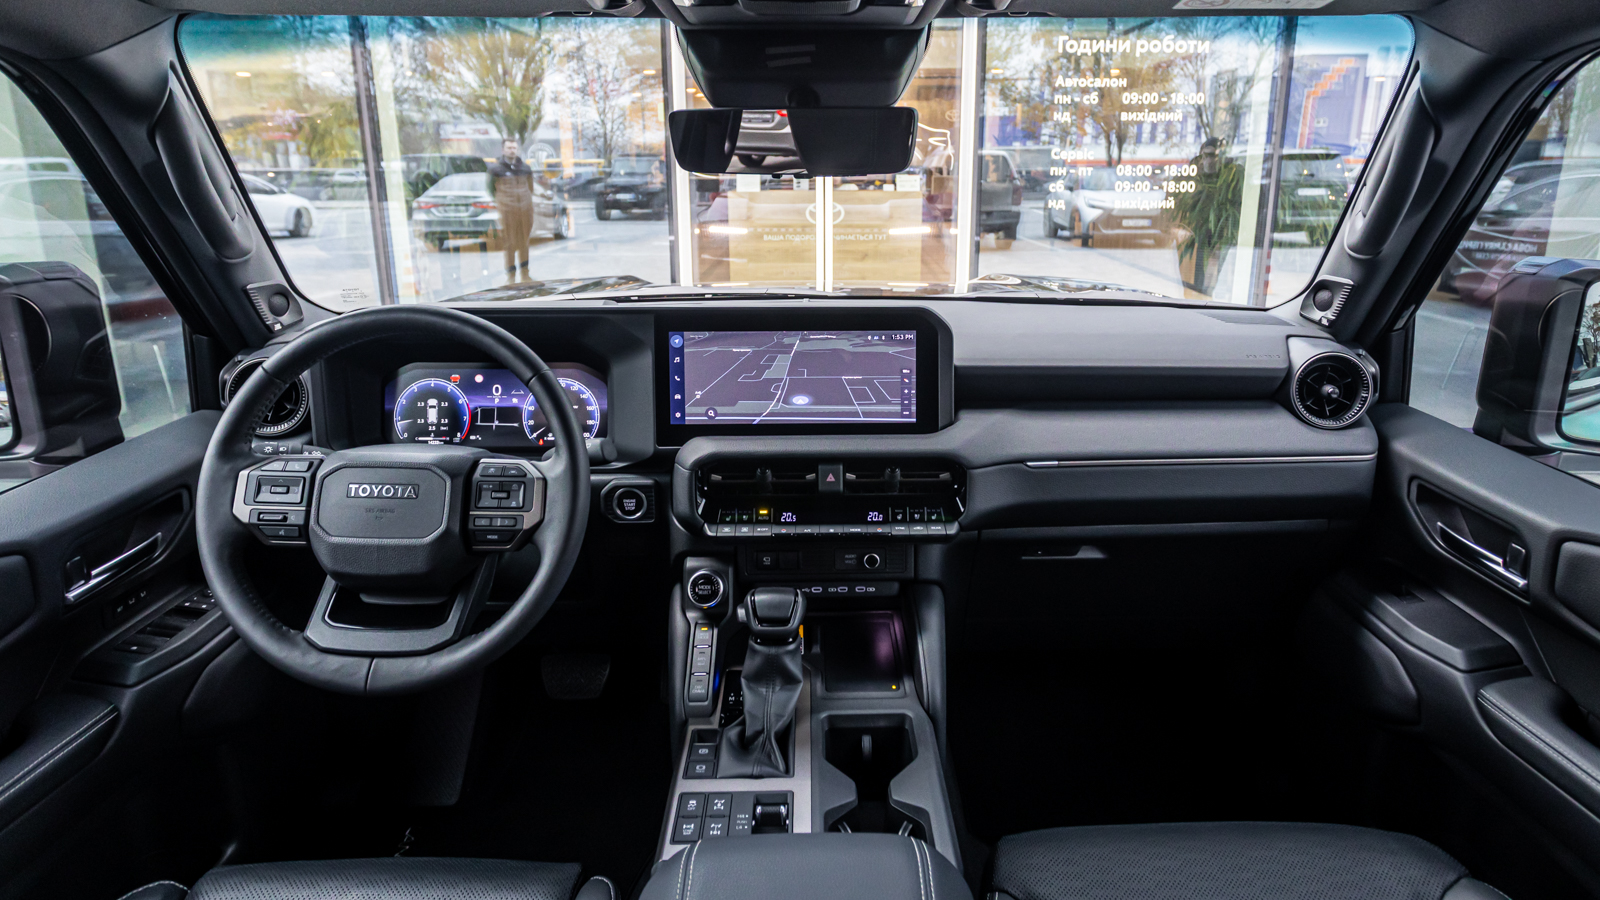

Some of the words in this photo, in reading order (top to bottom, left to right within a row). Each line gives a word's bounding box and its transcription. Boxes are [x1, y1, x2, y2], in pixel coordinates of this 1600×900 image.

[1058, 35, 1131, 56] Години
[1135, 34, 1210, 57] роботи
[1054, 75, 1127, 88] Автосалон
[1053, 94, 1071, 105] пн
[1082, 92, 1099, 105] сб
[1122, 92, 1158, 105] 09:00
[1170, 92, 1205, 105] 18:00
[1053, 111, 1071, 123] нд
[1120, 109, 1183, 123] вихідний
[1050, 148, 1094, 162] Сервіс
[1050, 166, 1067, 176] пн
[1078, 166, 1093, 176] пт
[1116, 164, 1152, 177] 08:00
[1163, 164, 1198, 177] 18:00
[1048, 180, 1065, 192] сб
[1114, 181, 1150, 193] 09:00
[1161, 181, 1196, 193] 18:00
[1047, 199, 1065, 211] нд
[1114, 197, 1175, 211] вихідний
[492, 384, 502, 396] 0
[348, 483, 417, 498] TOYOTA
[780, 512, 797, 522] 20.5
[867, 511, 883, 521] 20.0
